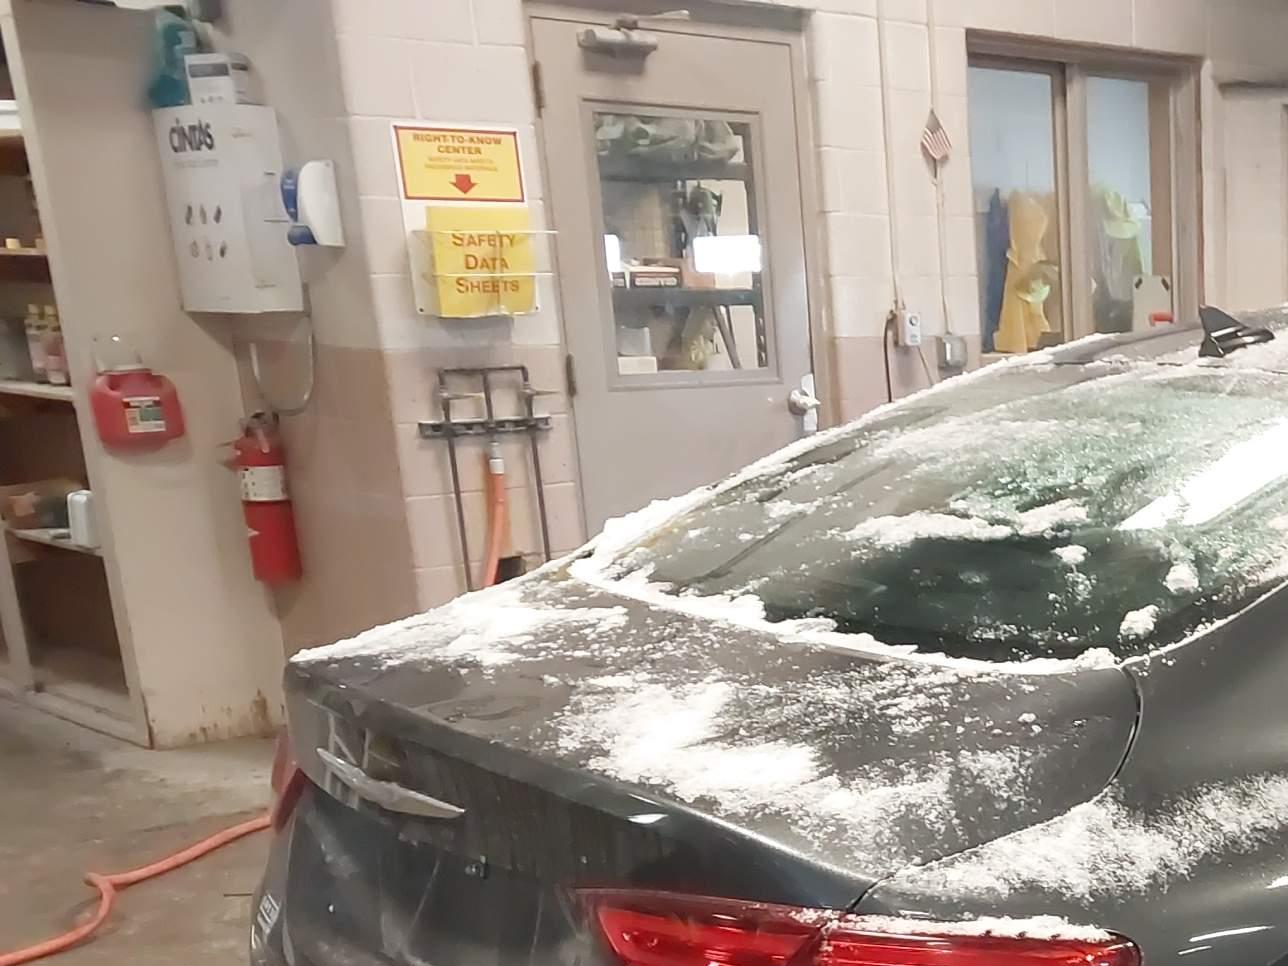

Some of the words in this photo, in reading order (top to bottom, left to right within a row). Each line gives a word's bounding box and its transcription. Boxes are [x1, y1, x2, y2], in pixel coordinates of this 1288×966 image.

[437, 145, 482, 155] CENTER
[464, 254, 509, 270] DATA
[455, 277, 520, 294] SHEETS
